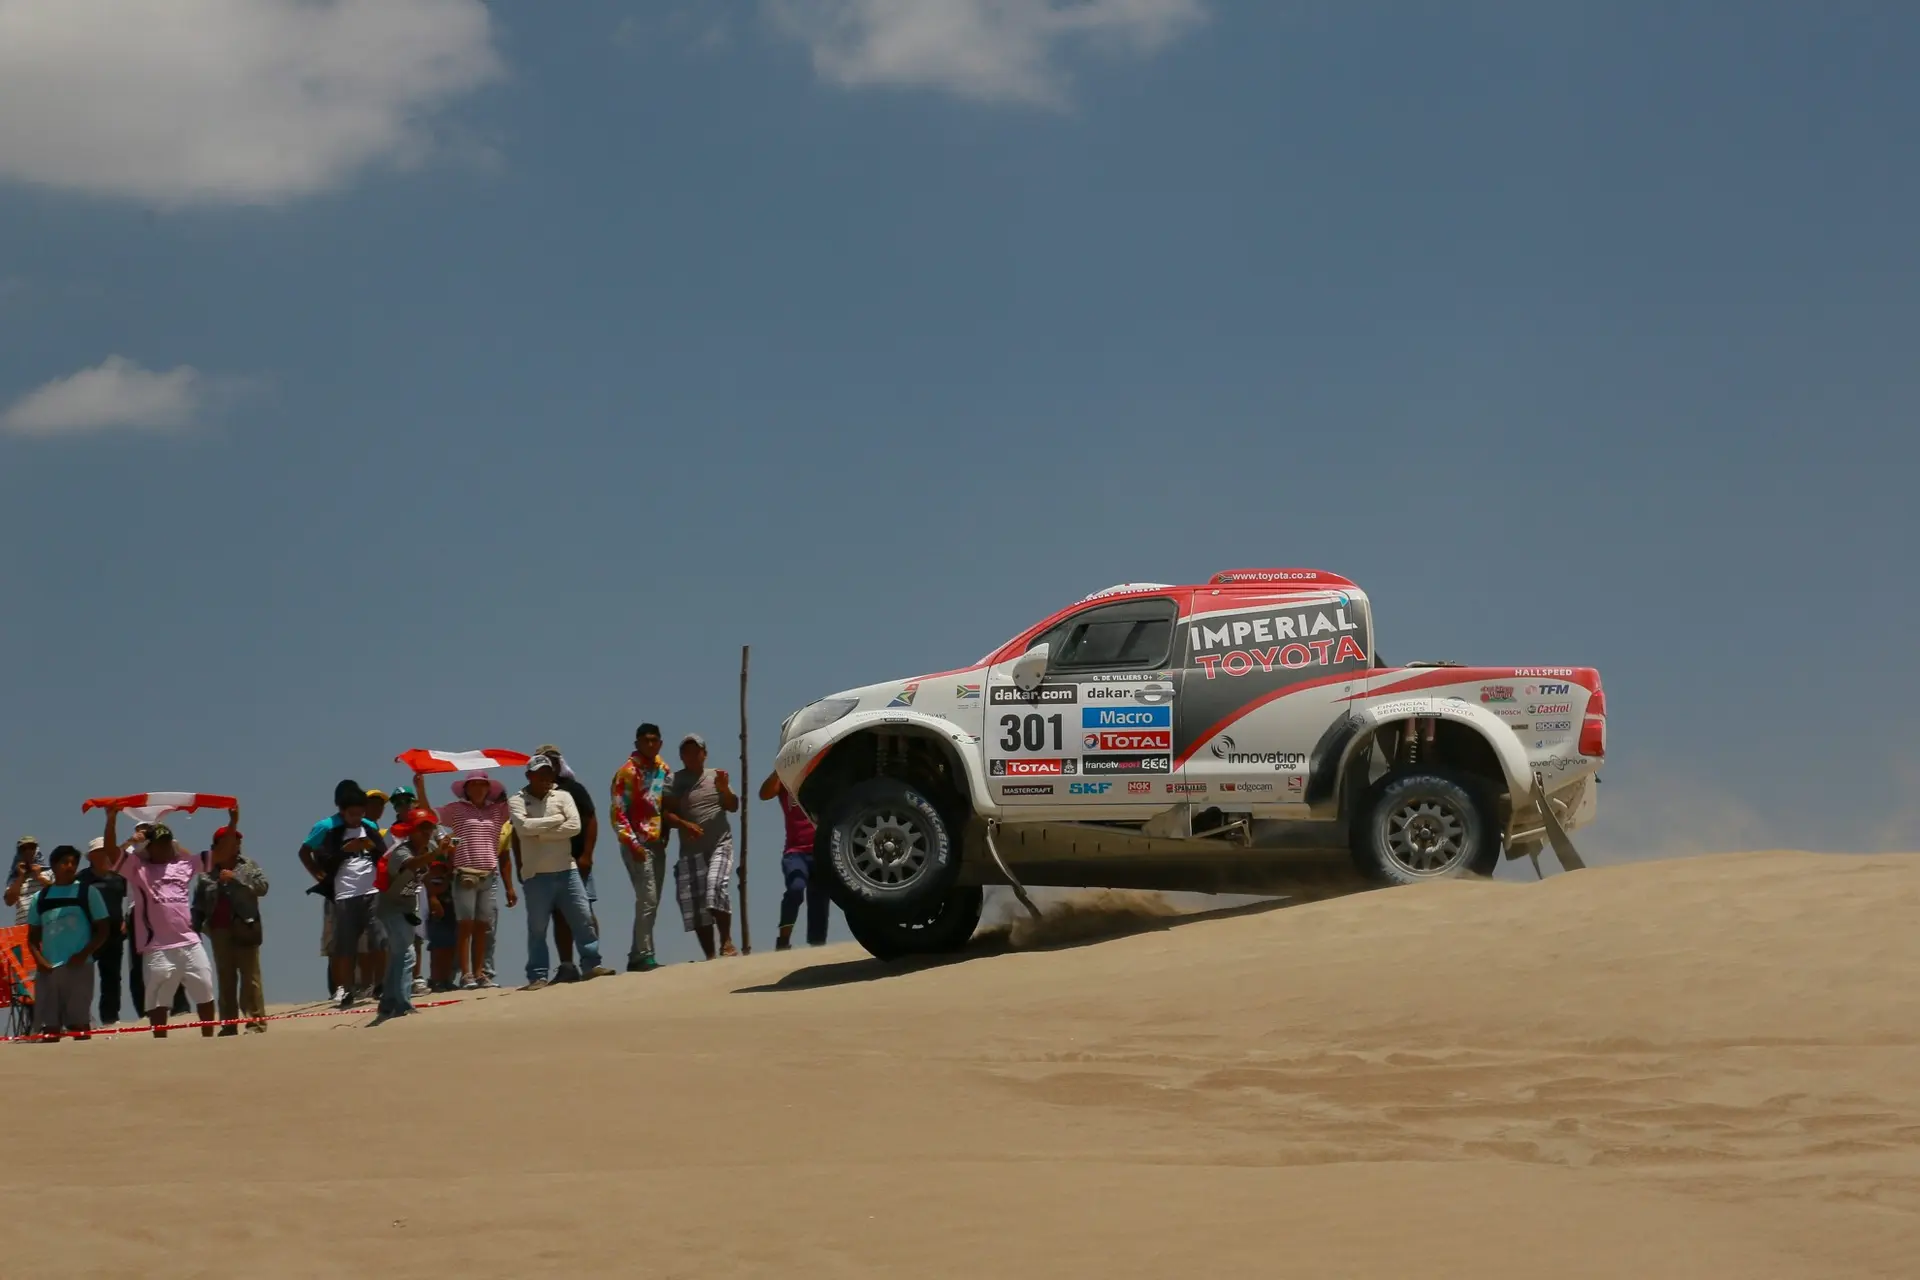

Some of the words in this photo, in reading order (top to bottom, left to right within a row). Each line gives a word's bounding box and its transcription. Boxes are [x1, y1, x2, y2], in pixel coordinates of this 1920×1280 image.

[1232, 572, 1317, 582] www.toyota.co.za
[1191, 608, 1358, 650] IMPERIAL
[1195, 634, 1367, 680] TOYOTA
[1112, 674, 1142, 682] VILLIERS
[1514, 668, 1573, 677] HALLSPEED
[994, 687, 1073, 701] dakar.com
[1538, 684, 1570, 695] TFM
[1537, 704, 1570, 714] Castrol
[1100, 710, 1154, 725] Macro
[1000, 713, 1063, 752] 301
[1103, 734, 1168, 748] TOTAL
[1228, 751, 1306, 764] innovation
[1008, 761, 1060, 773] TOTAL
[1274, 763, 1297, 771] group
[1003, 786, 1052, 796] MASTERCRAFT
[1069, 783, 1113, 795] SKF
[1128, 782, 1150, 791] NGK
[1236, 782, 1273, 792] edgecam
